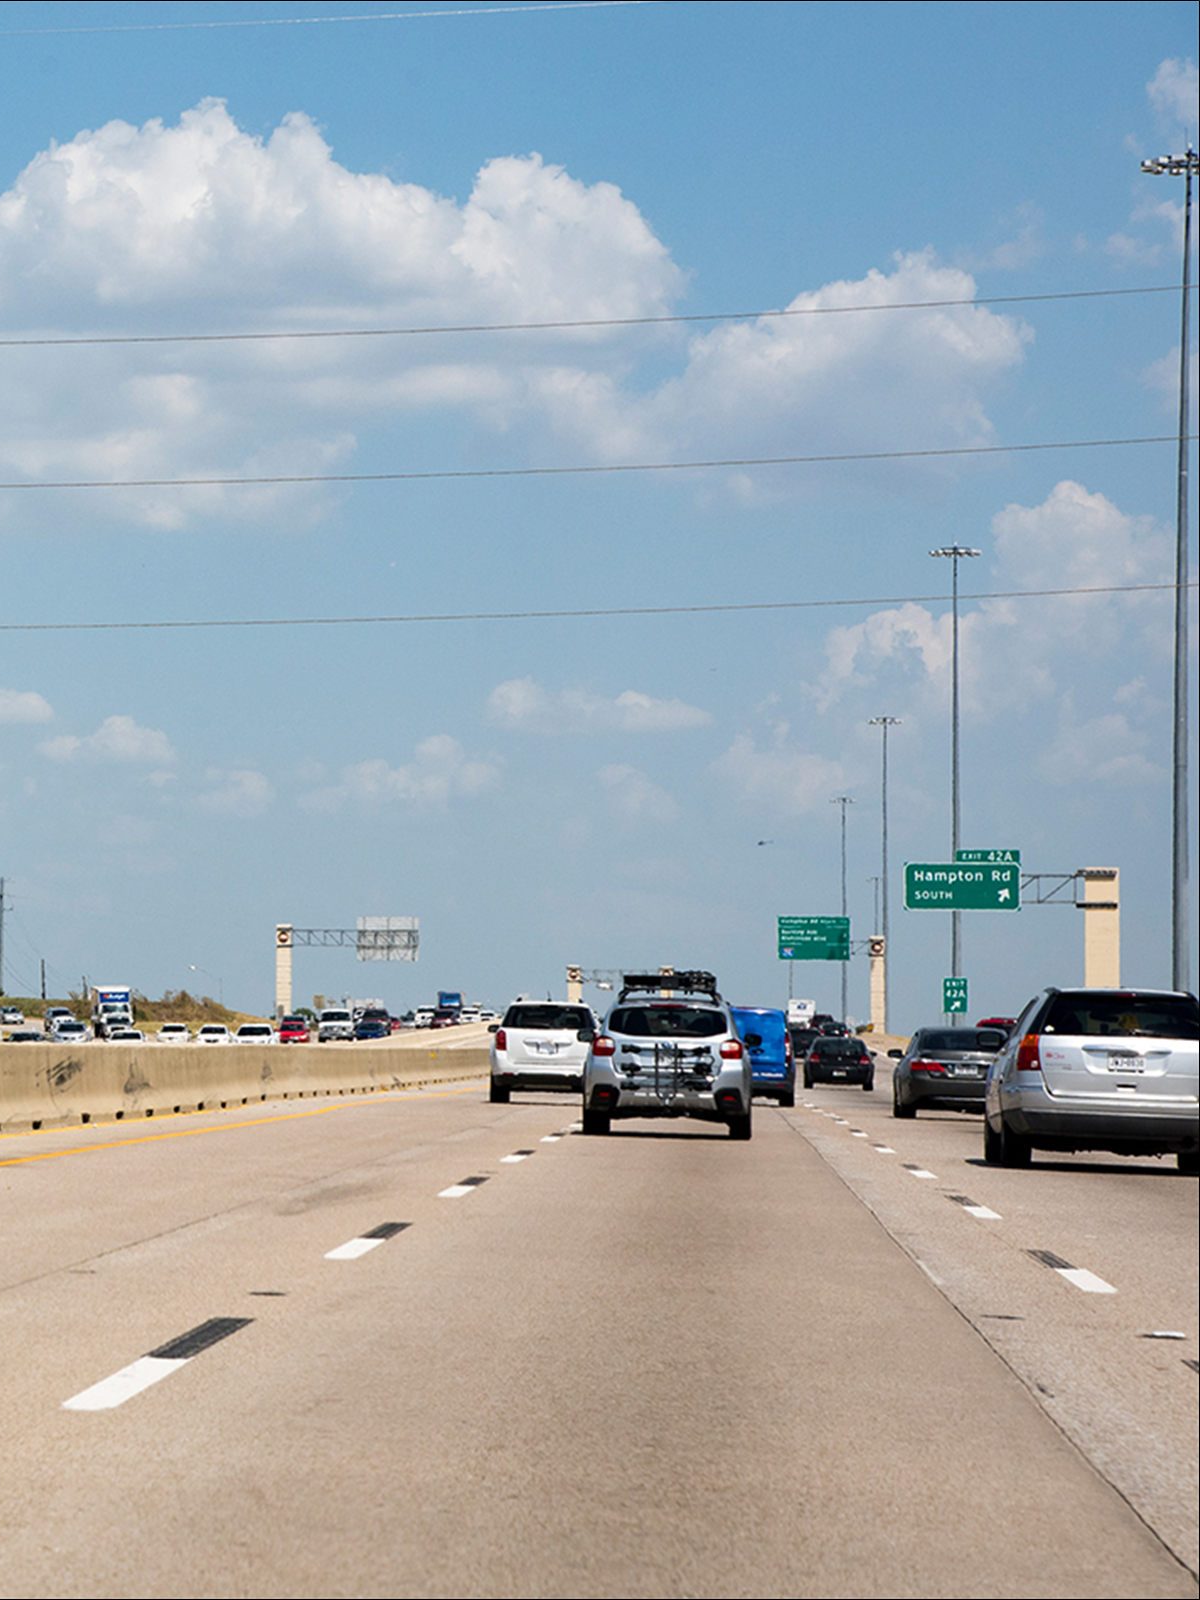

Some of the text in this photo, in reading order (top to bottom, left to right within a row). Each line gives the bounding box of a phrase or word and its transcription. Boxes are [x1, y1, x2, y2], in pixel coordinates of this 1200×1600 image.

[987, 851, 1013, 861] 42A
[914, 870, 1011, 884] Hampton Rd
[914, 890, 953, 900] SOUTH
[945, 989, 966, 998] 42A
